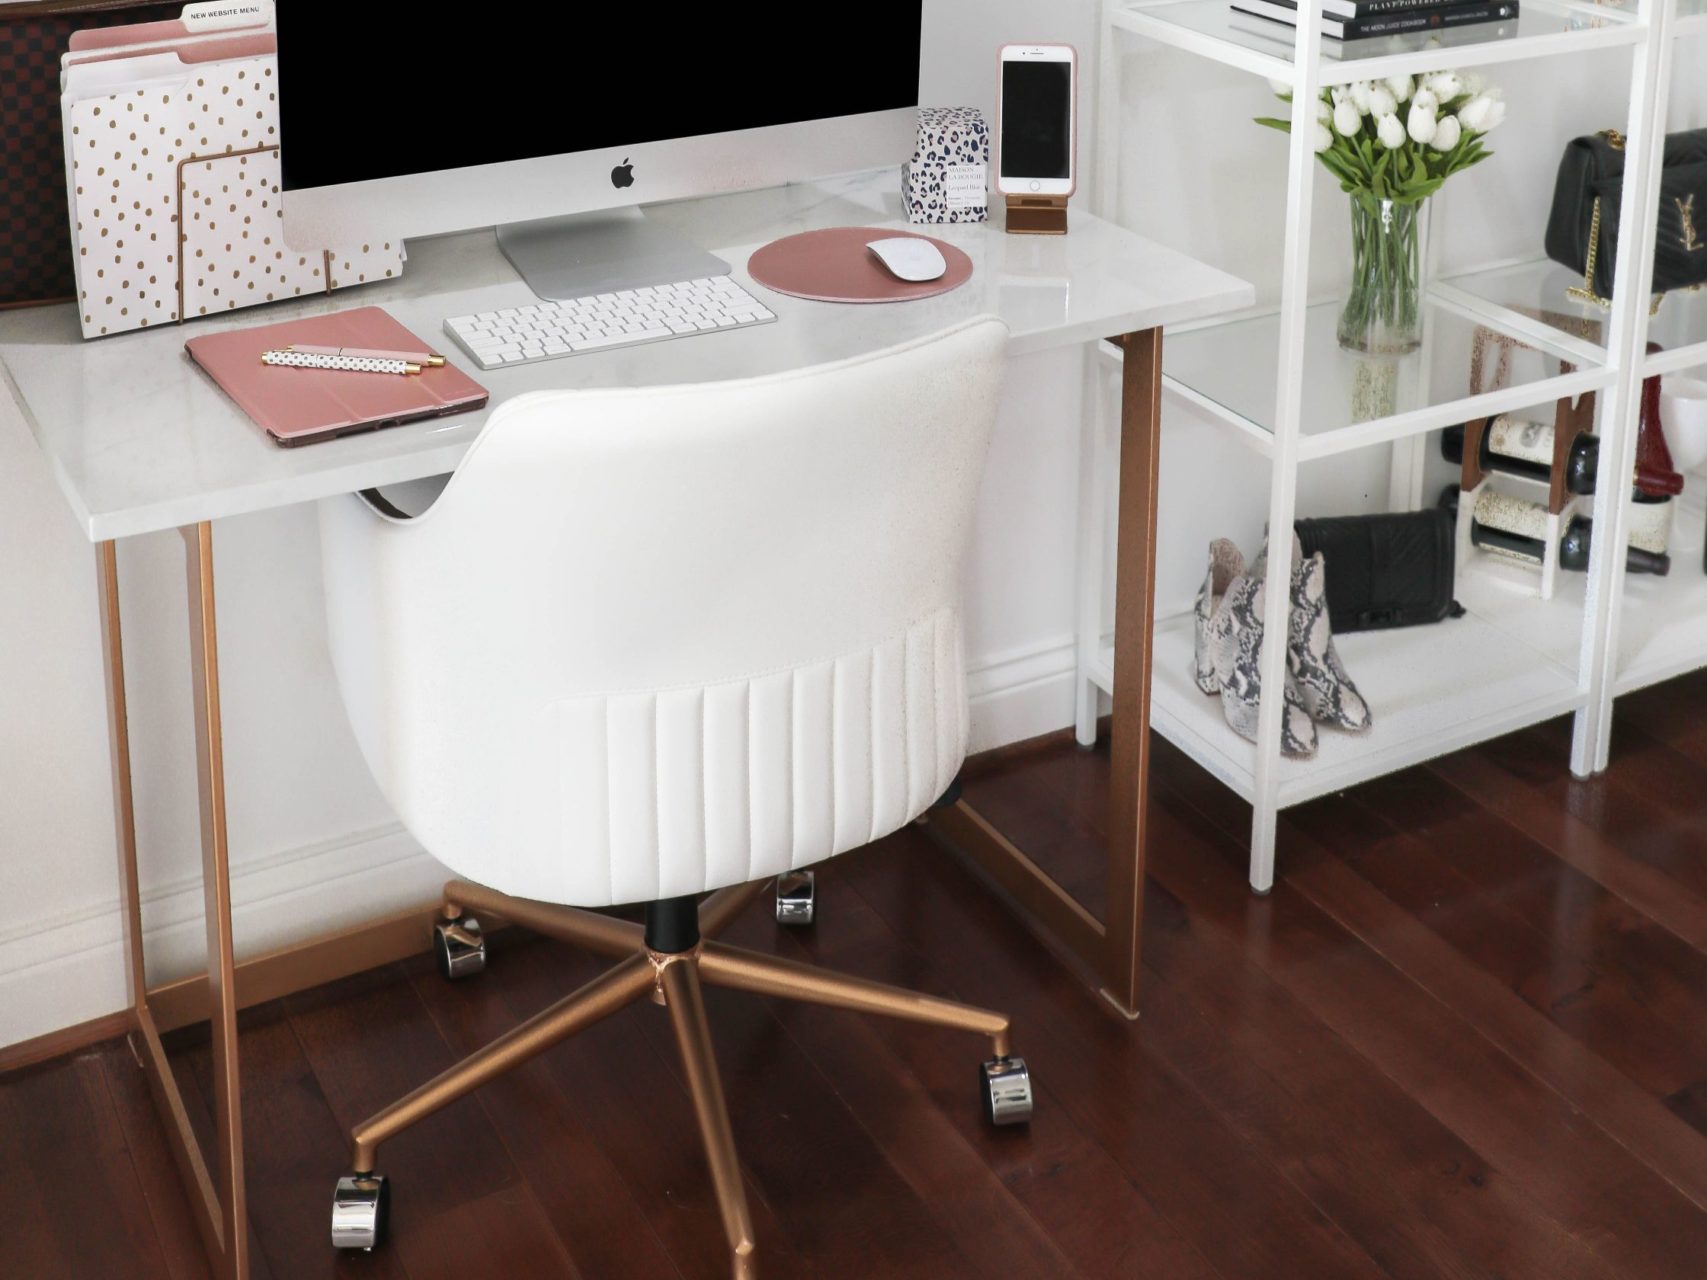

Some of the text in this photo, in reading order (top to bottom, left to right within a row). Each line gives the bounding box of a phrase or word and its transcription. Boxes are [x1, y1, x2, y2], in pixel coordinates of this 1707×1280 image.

[1369, 0, 1397, 11] PLANT
[190, 6, 260, 20] NEW WEBSITE MENU
